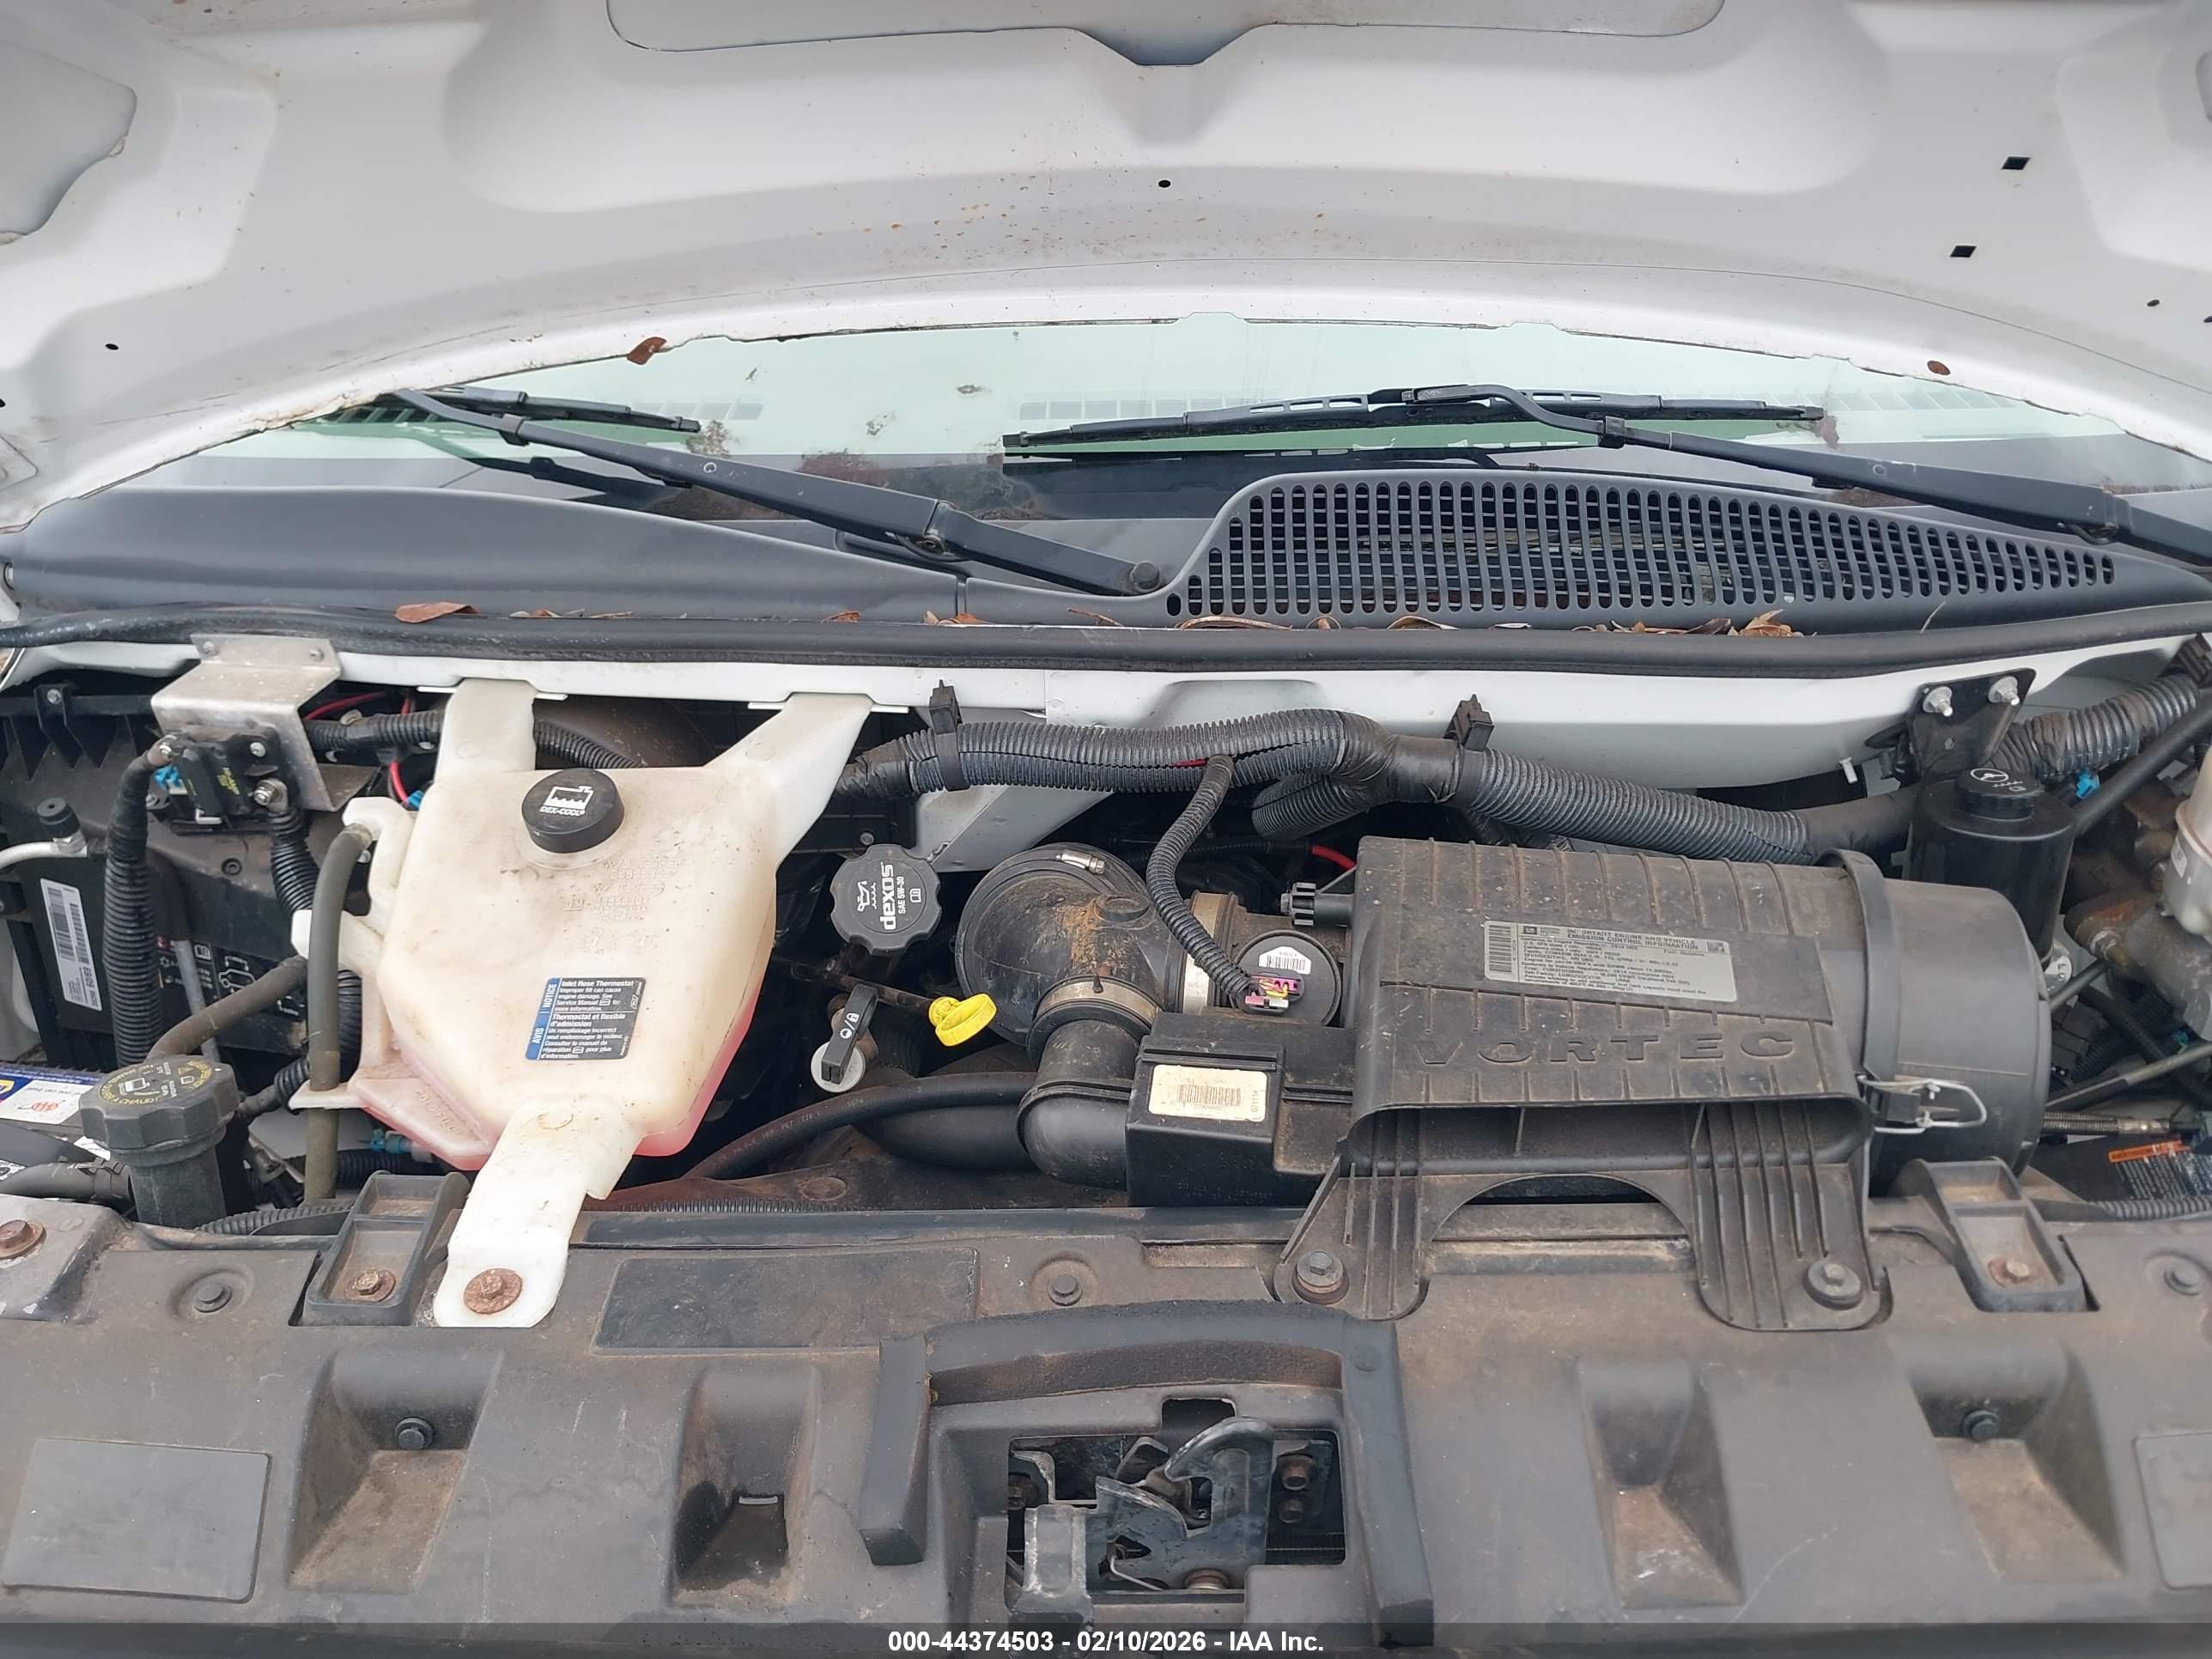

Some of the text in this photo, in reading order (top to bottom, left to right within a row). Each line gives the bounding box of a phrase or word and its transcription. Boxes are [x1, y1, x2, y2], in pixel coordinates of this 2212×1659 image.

[879, 863, 896, 930] dexos
[896, 876, 906, 915] SAE 5W-30
[1644, 940, 1699, 950] INFORMATION
[542, 983, 557, 1009] NOTICE
[532, 1027, 544, 1044] AVIS
[1416, 1030, 1795, 1065] VORTEC
